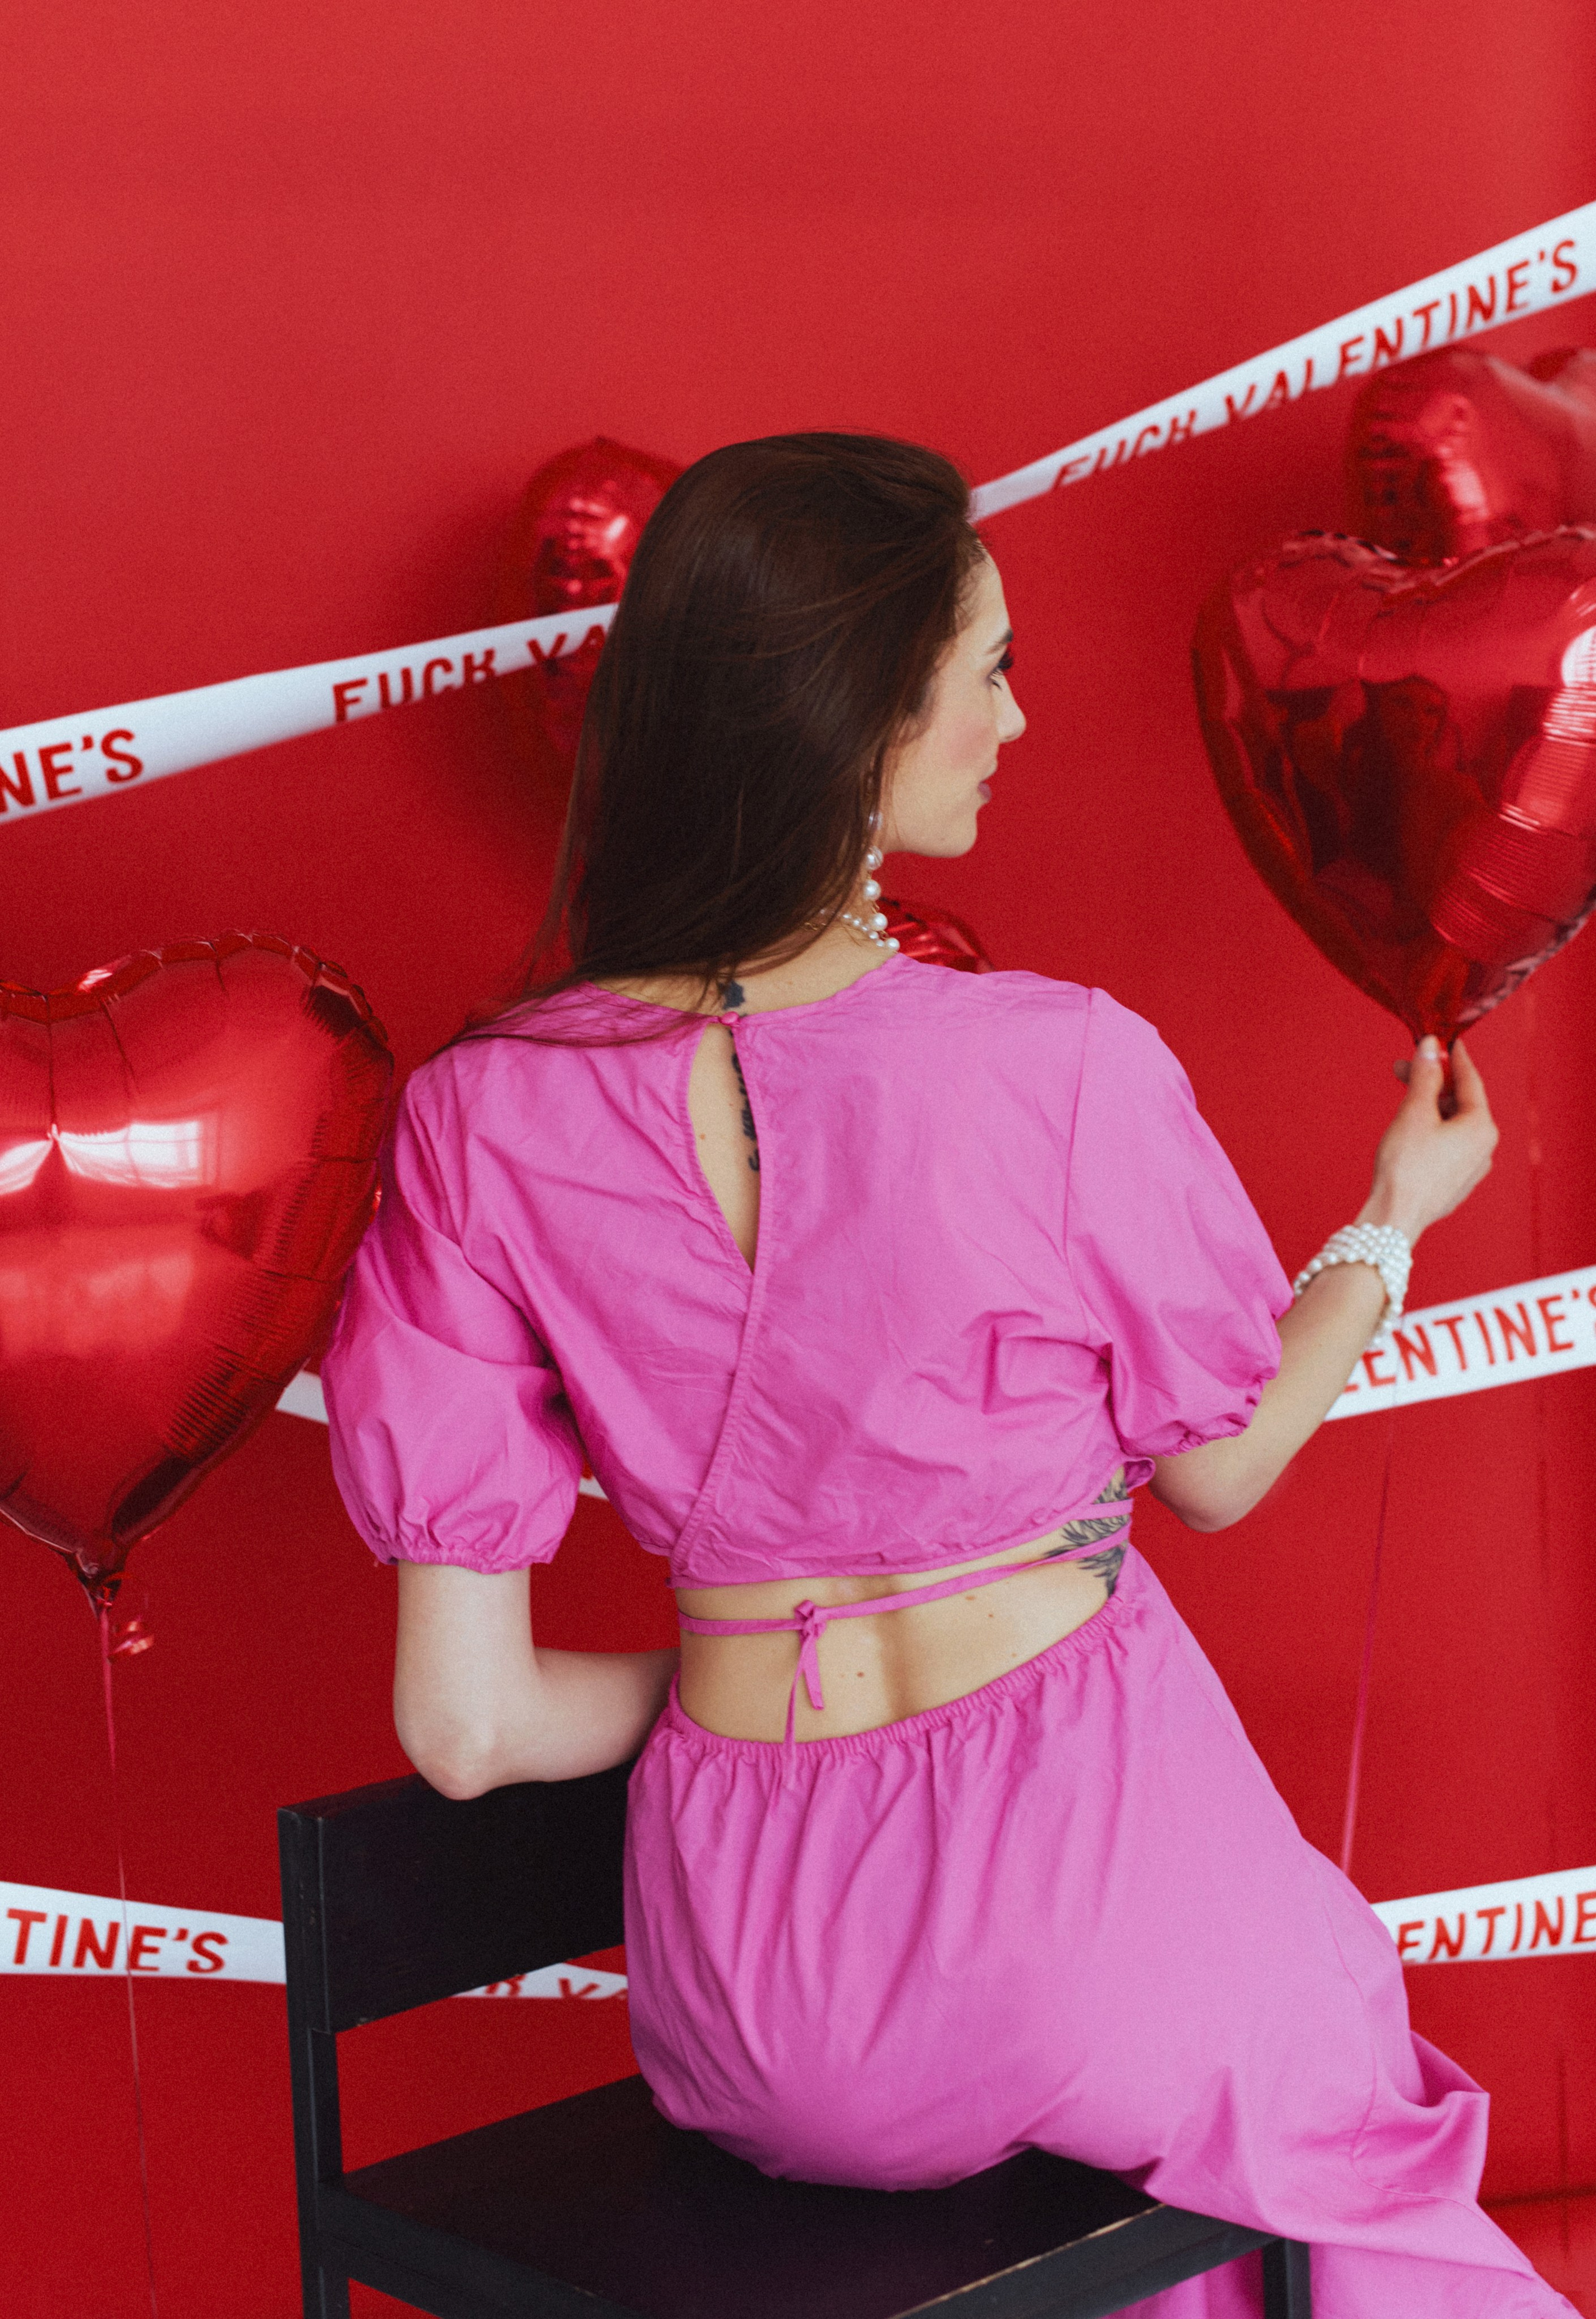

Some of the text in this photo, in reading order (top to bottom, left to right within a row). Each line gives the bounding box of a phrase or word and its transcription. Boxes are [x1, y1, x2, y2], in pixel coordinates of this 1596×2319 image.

[332, 647, 496, 723] FUCK
[1342, 1284, 1596, 1393] ENTINE'
[7, 1908, 229, 1974] TINE'S
